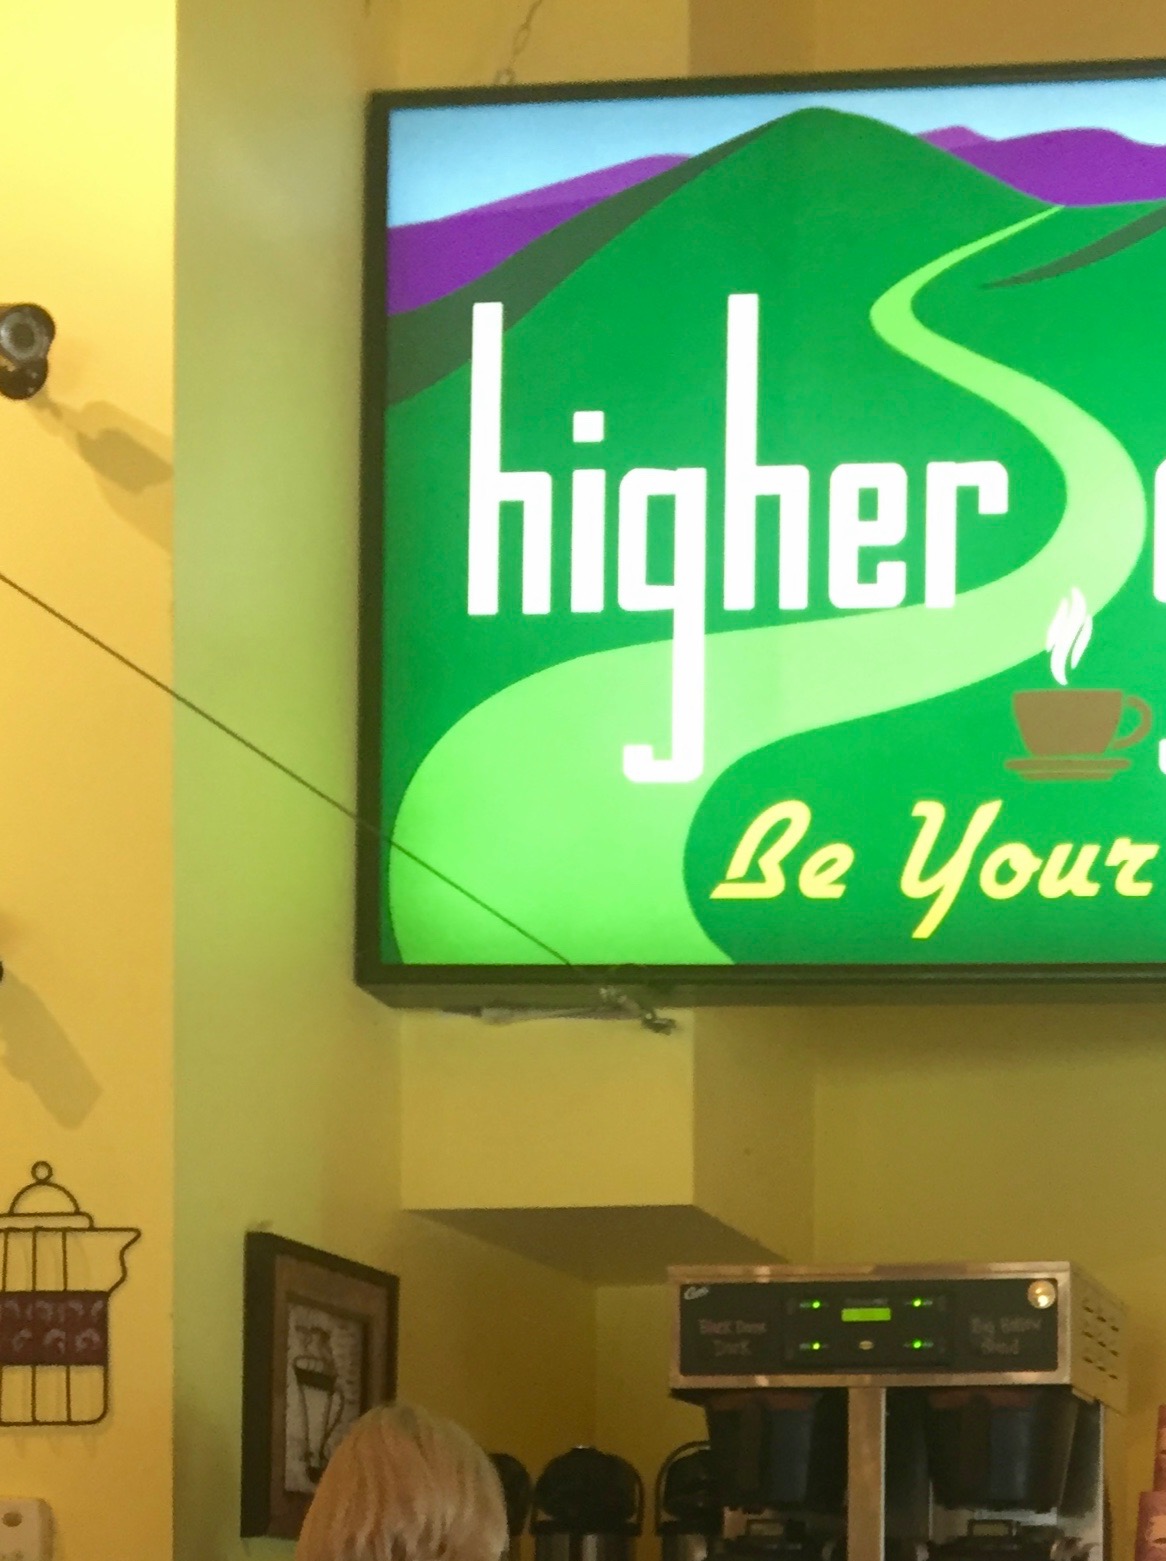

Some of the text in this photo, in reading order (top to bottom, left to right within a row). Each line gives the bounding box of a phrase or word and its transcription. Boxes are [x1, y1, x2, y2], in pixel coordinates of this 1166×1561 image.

[467, 292, 1009, 785] higher
[709, 799, 855, 899] Be
[900, 799, 1160, 939] Your
